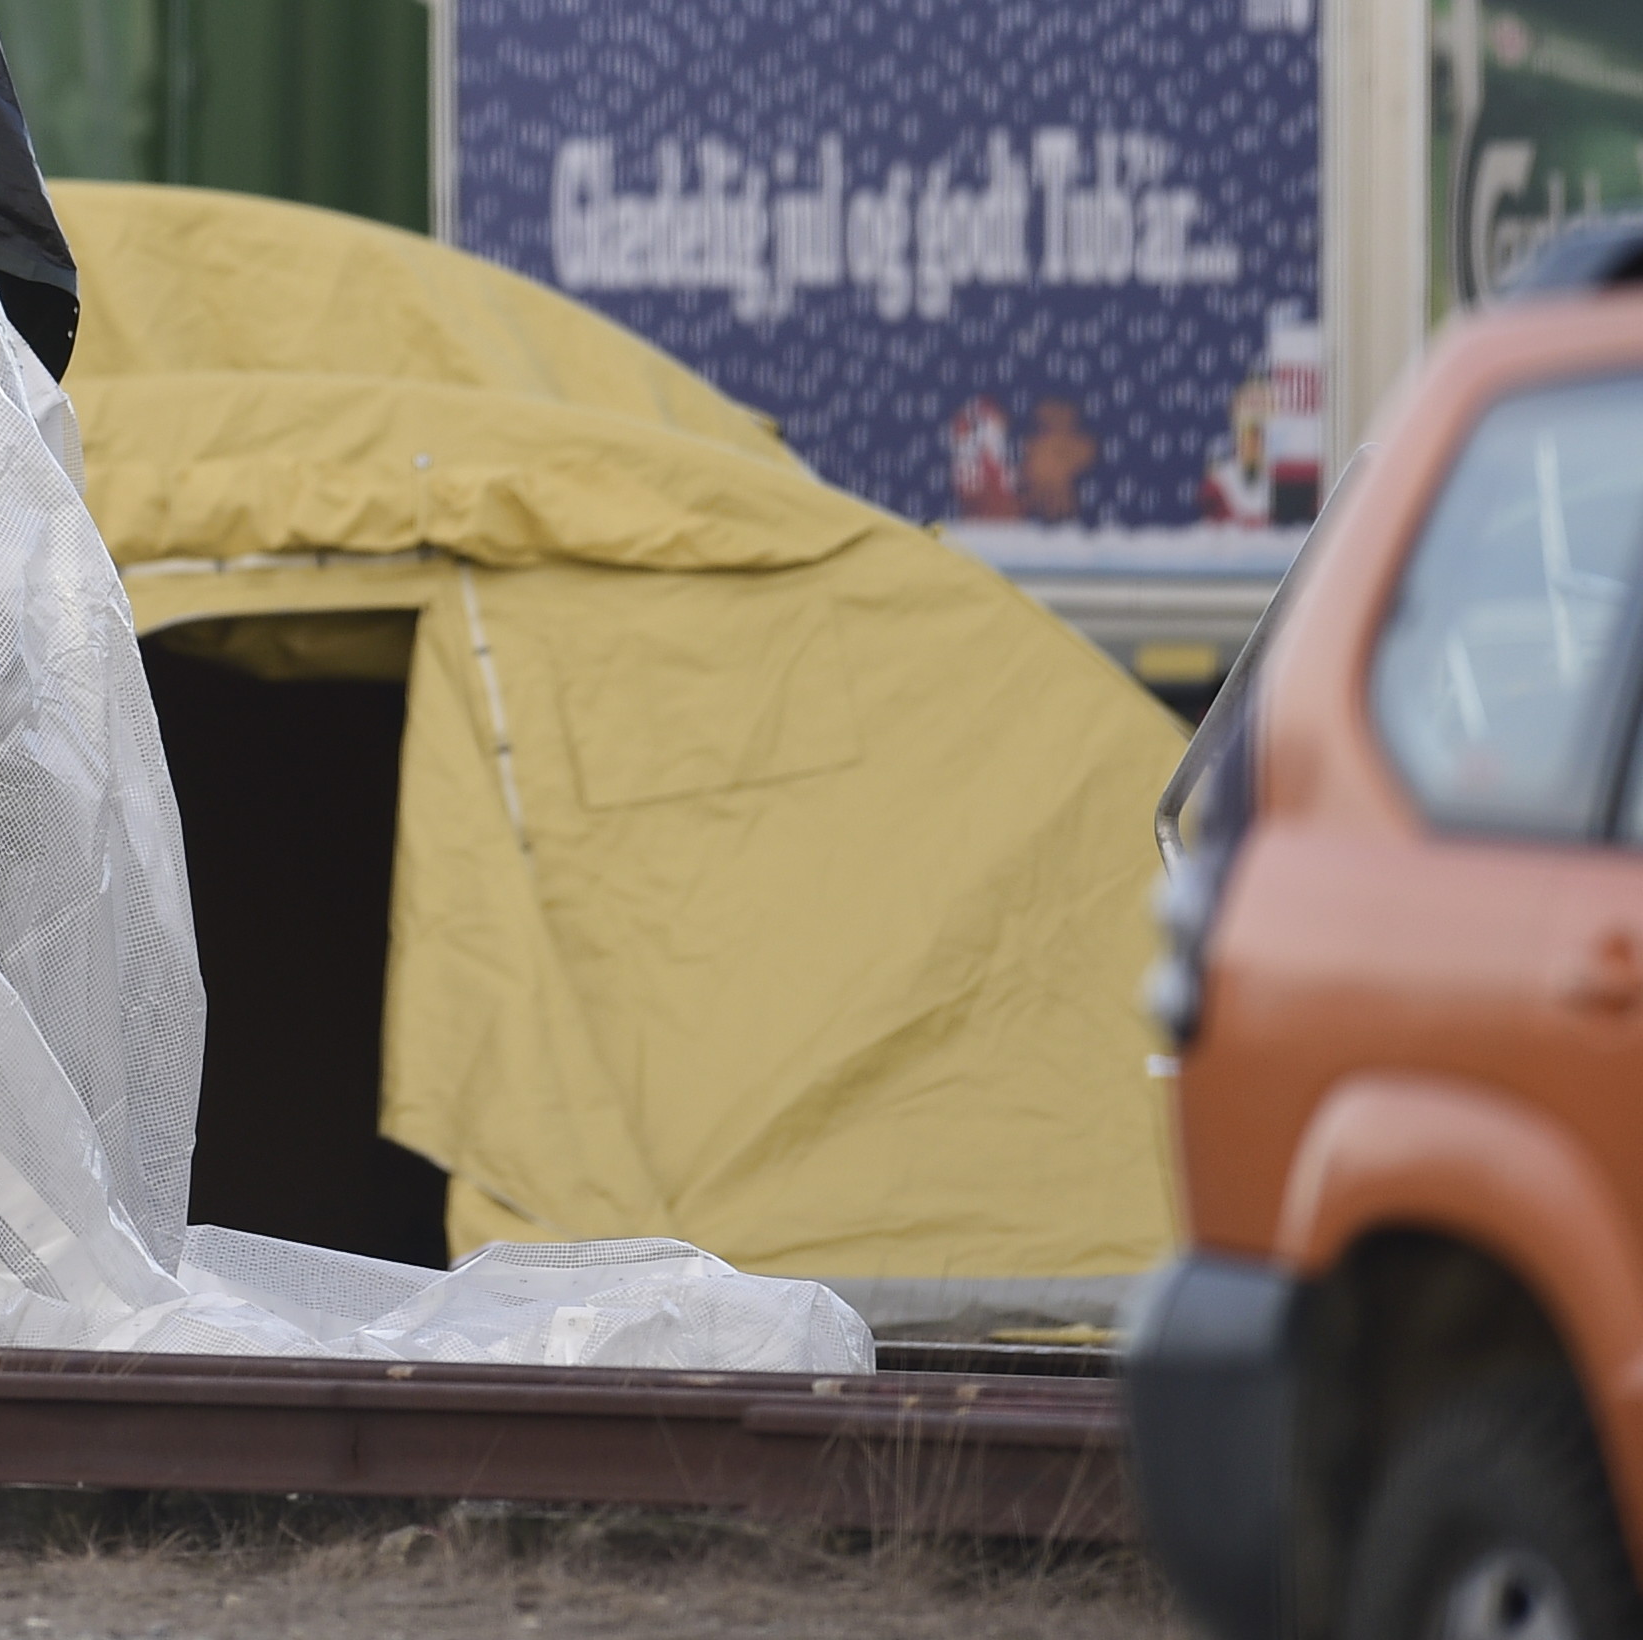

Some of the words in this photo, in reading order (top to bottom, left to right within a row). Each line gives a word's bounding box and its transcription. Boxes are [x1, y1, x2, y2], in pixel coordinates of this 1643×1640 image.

[768, 130, 844, 323] jul
[846, 160, 913, 323] og
[916, 128, 1030, 322] godt
